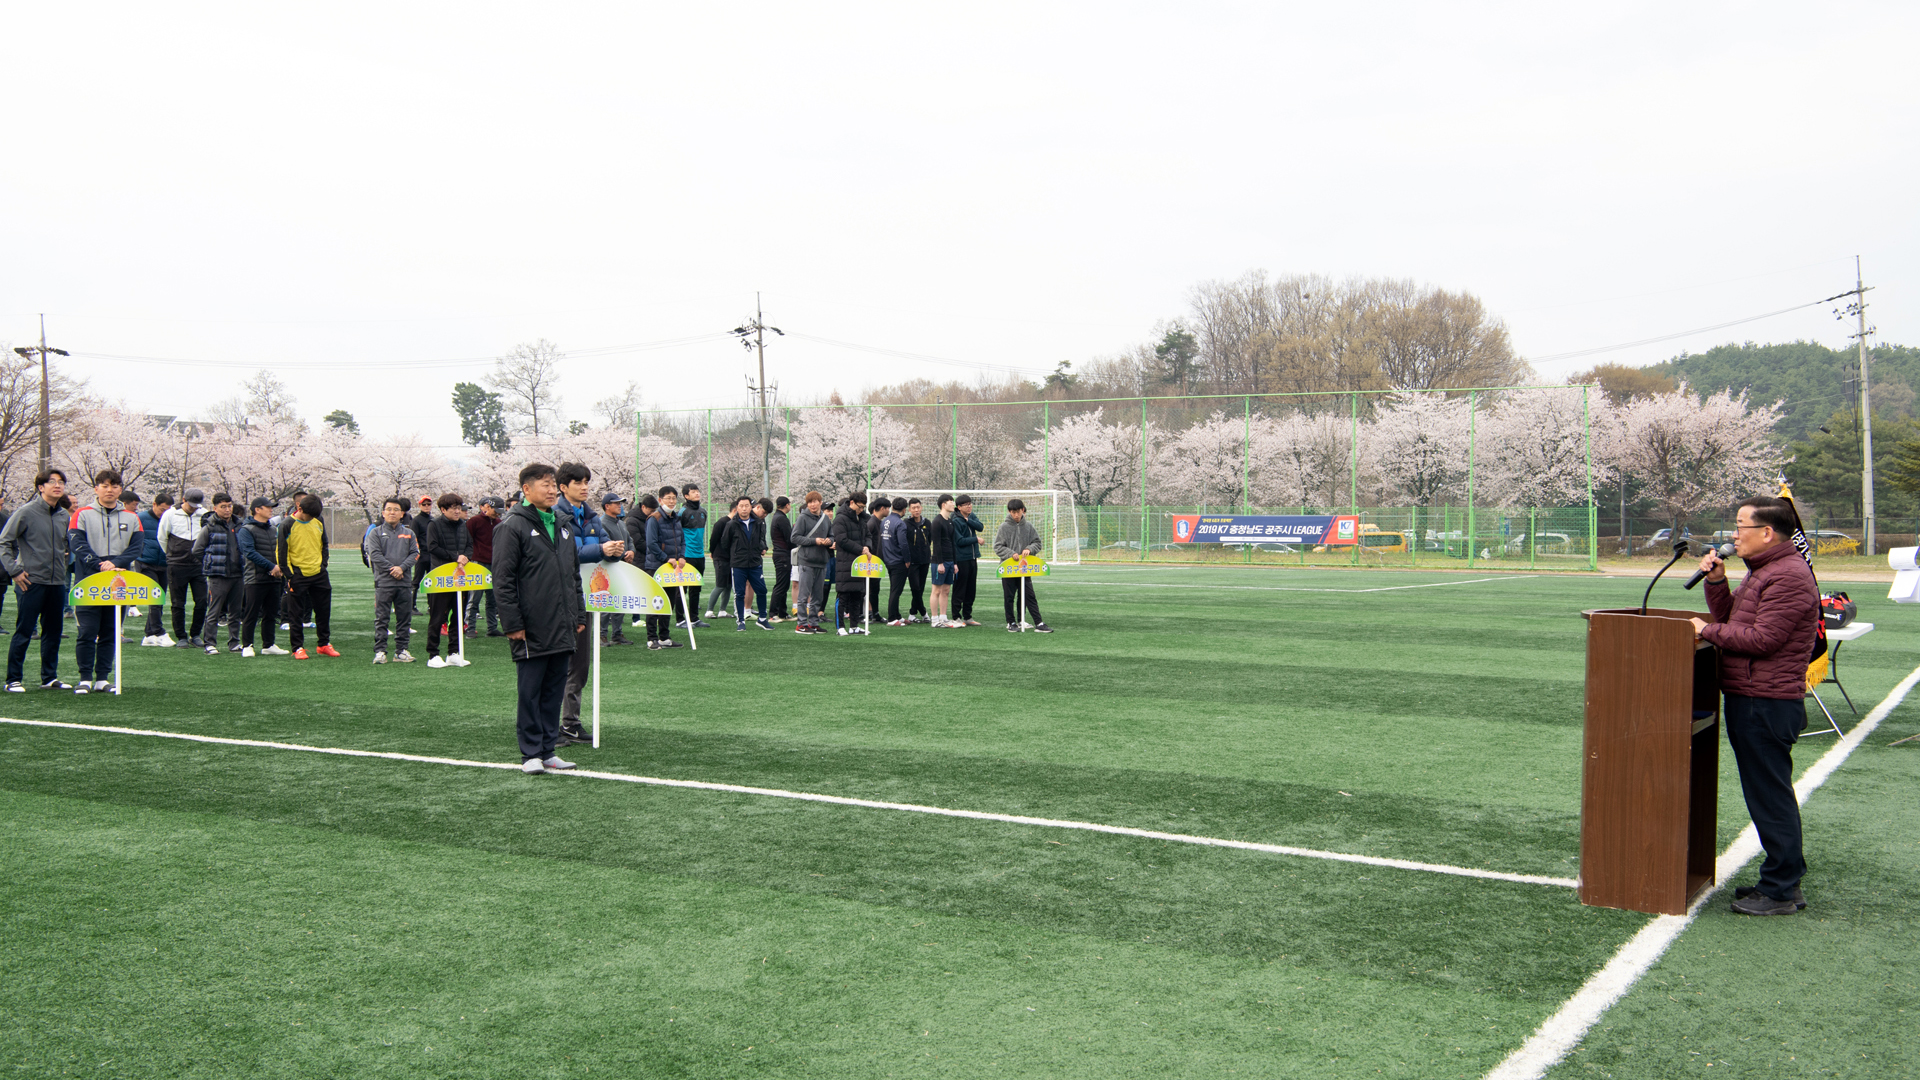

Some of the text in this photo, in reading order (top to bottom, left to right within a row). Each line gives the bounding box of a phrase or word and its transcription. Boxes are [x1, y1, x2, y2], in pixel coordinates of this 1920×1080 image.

[1198, 525, 1323, 535] 2019 K7 충청남도 공주시 LEAGUE
[1340, 521, 1352, 530] K7
[1006, 564, 1040, 574] 유구 축구회
[435, 574, 483, 588] 계룡 축구회
[663, 572, 696, 583] 금강 축구회
[89, 586, 148, 600] 우성 축구회
[588, 593, 620, 609] 축구동호인
[621, 594, 647, 609] 클럽리그
